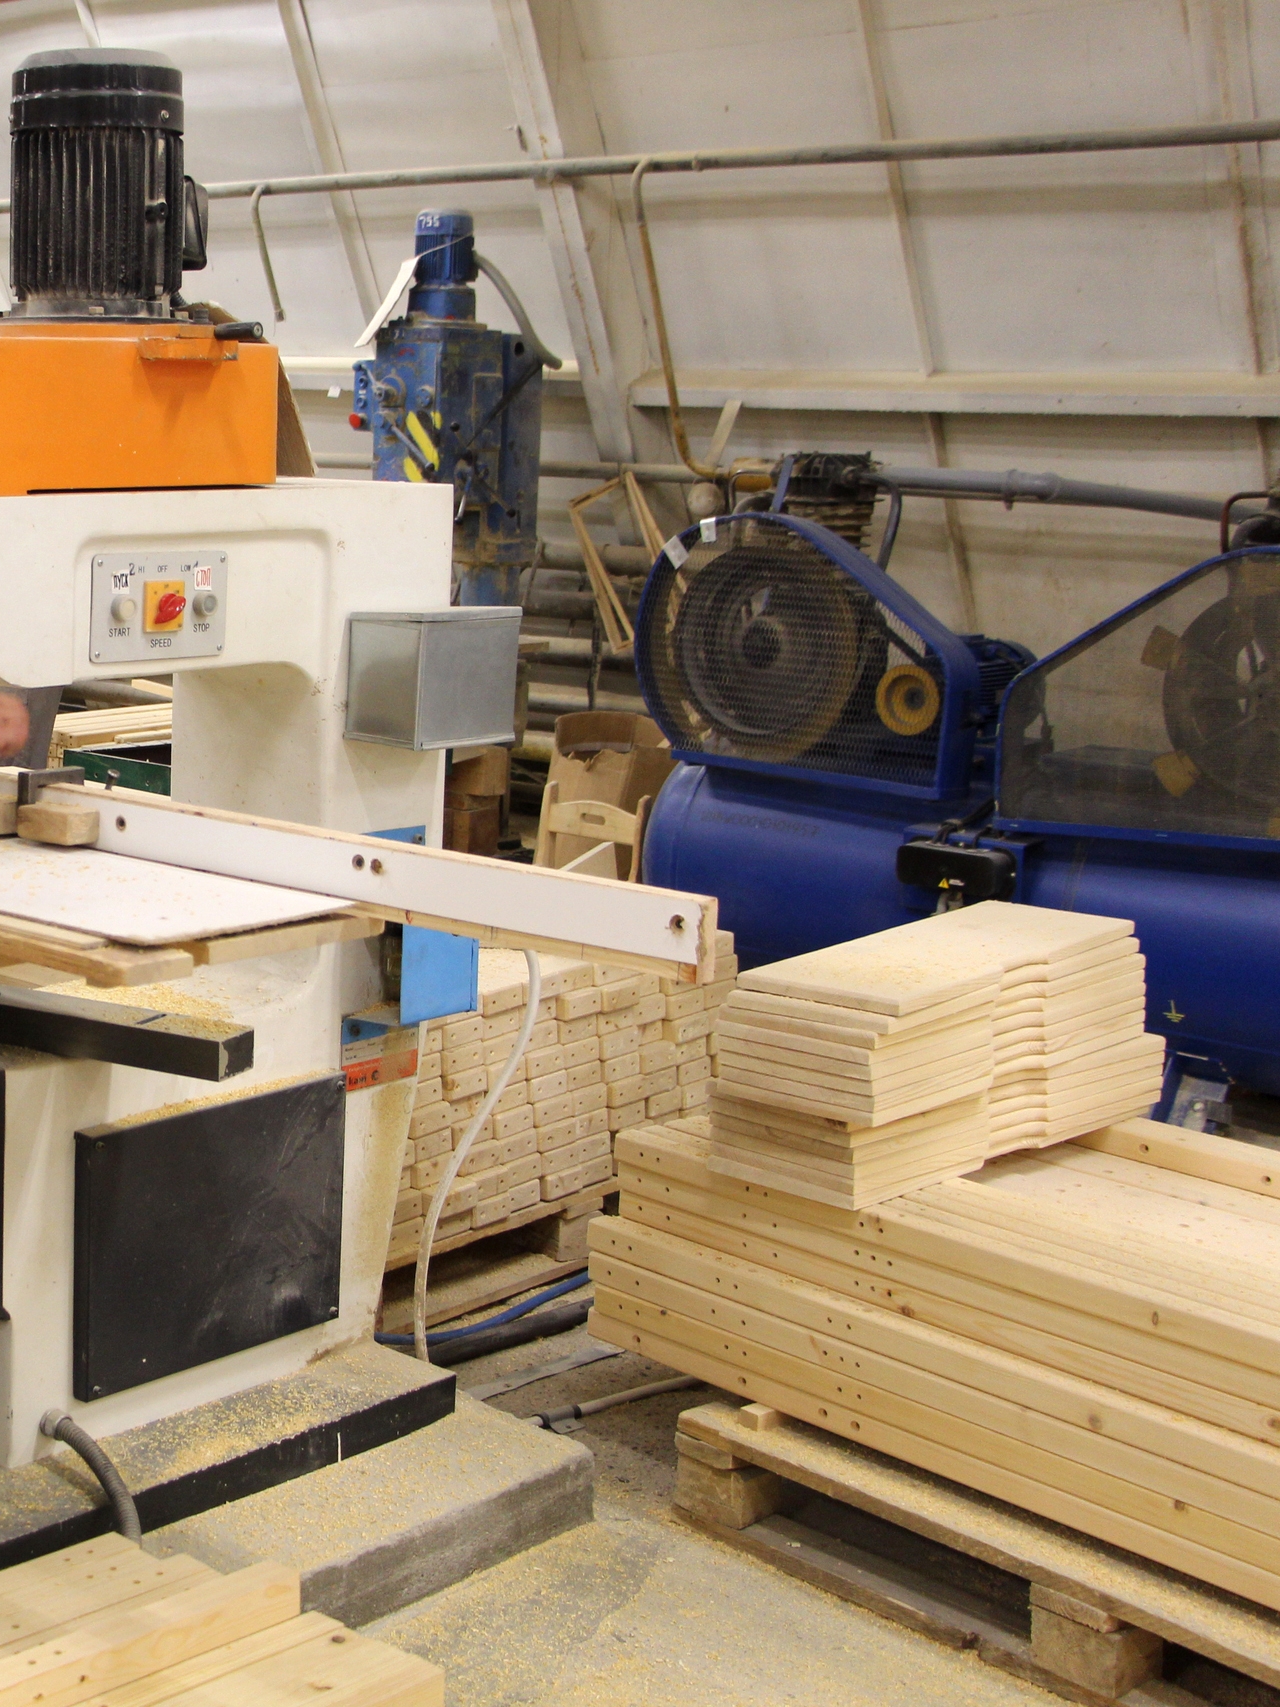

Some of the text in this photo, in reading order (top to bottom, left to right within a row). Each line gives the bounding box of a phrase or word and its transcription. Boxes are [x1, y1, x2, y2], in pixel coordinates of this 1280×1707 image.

[129, 562, 135, 576] 2
[158, 565, 168, 573] OFF
[181, 564, 191, 572] LOW
[114, 573, 128, 590] ПУСК
[196, 568, 211, 586] СТОП
[109, 627, 130, 638] START
[193, 623, 210, 633] STOP
[150, 638, 172, 649] SPEED
